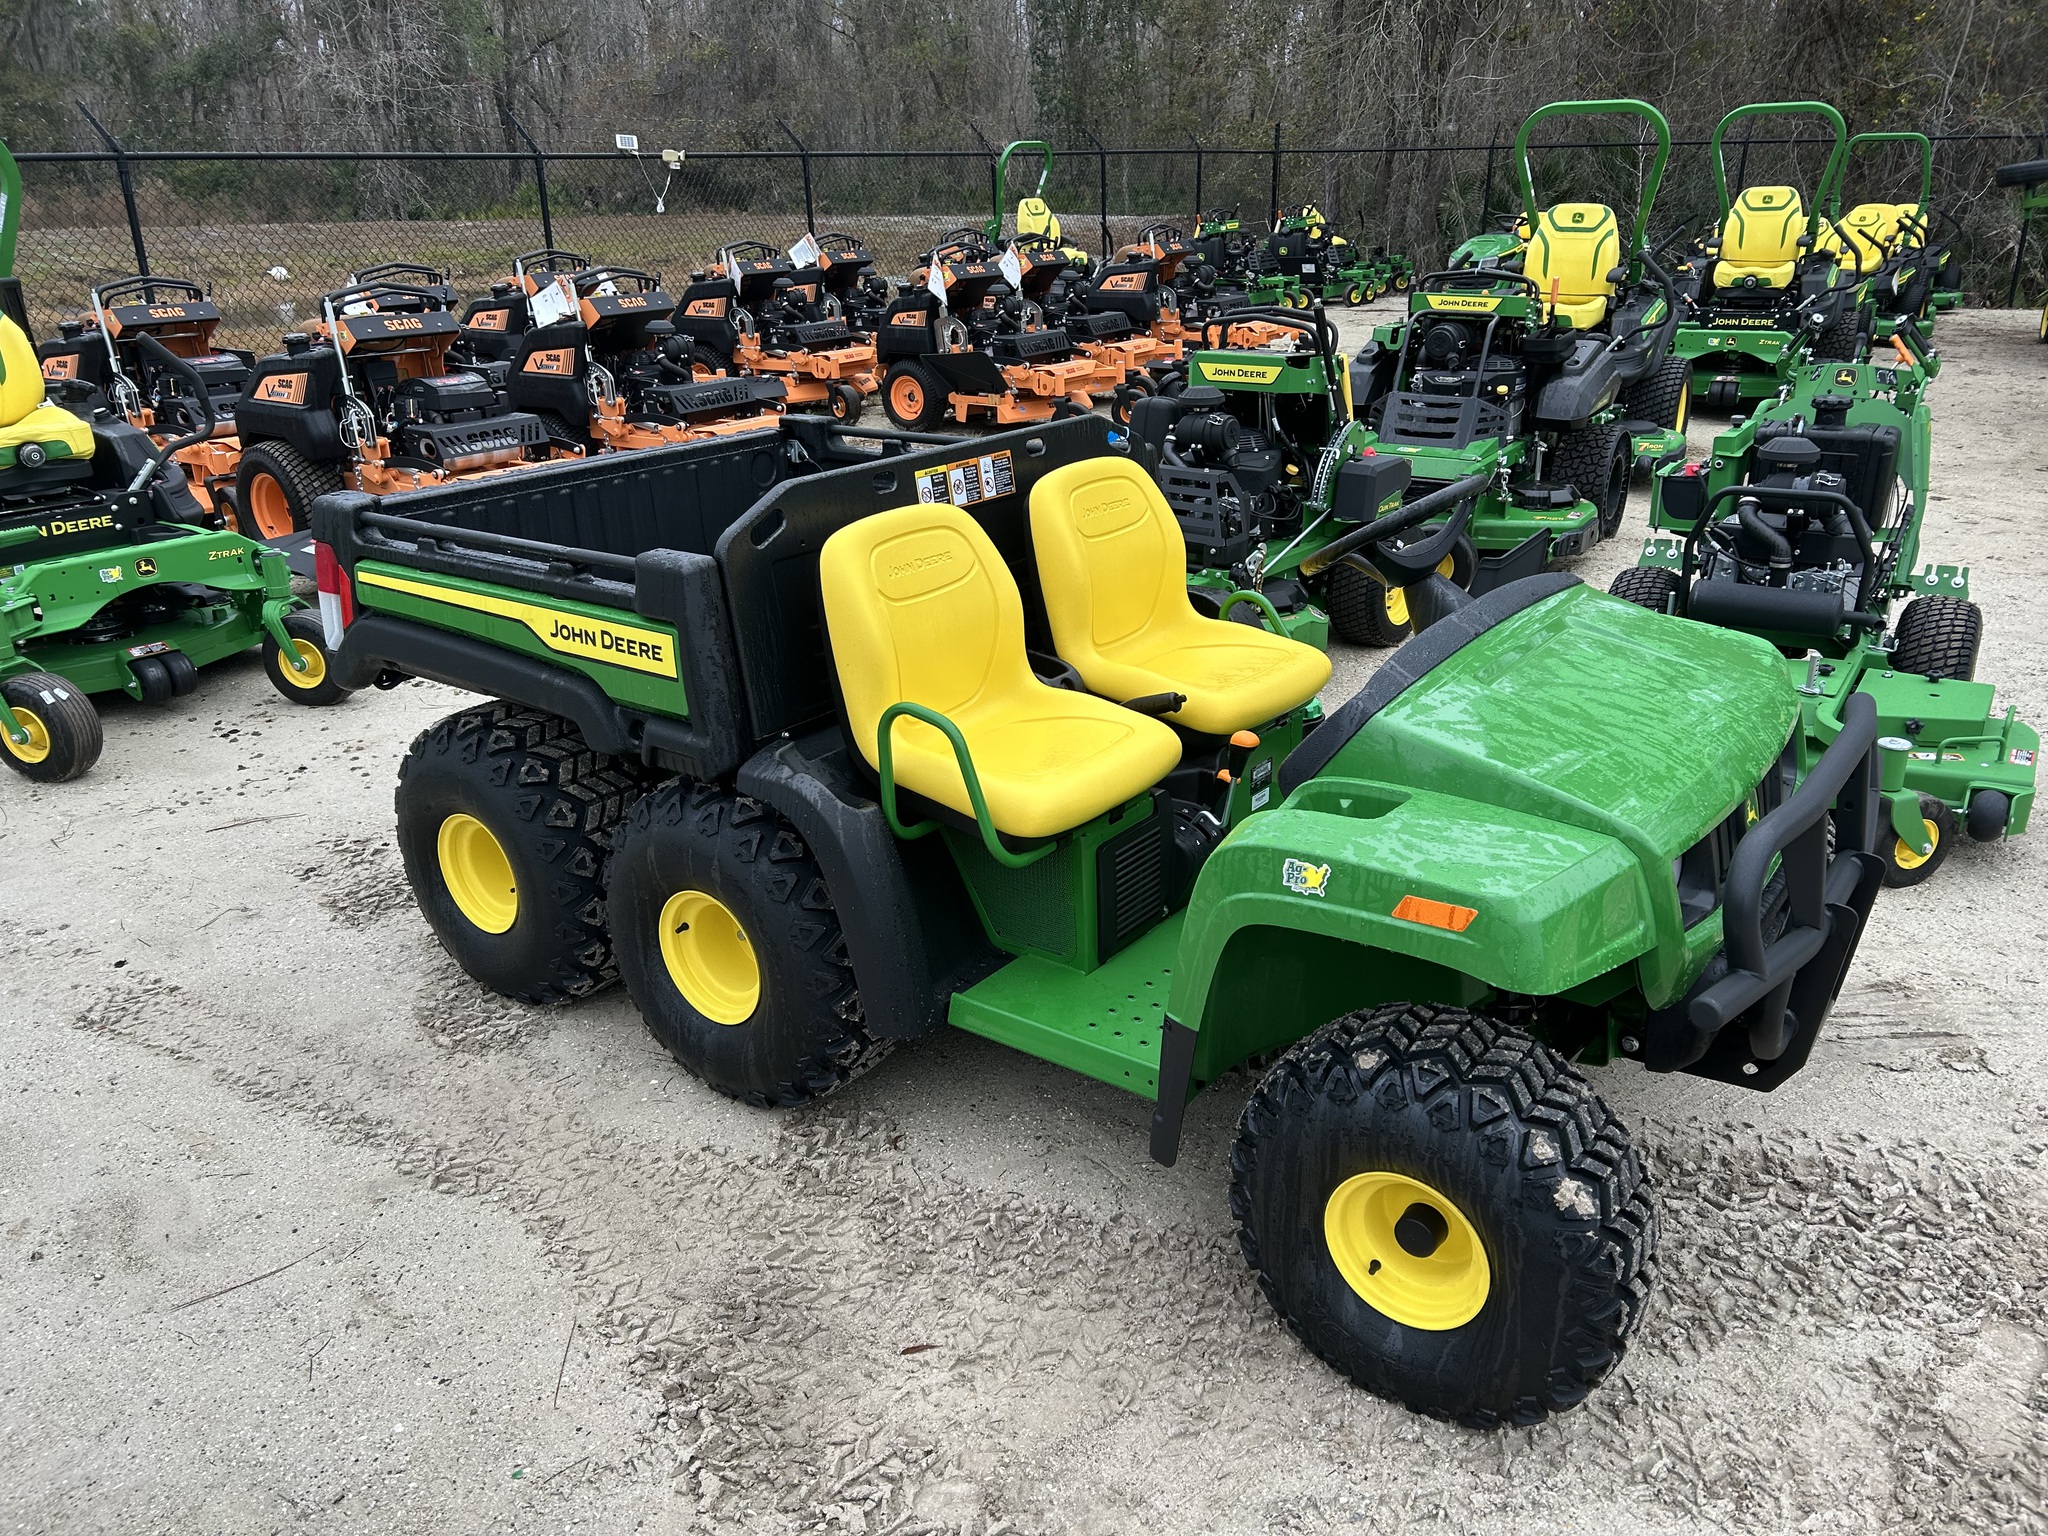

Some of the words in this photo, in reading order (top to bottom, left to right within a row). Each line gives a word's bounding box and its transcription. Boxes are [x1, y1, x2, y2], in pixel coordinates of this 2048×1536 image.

[753, 262, 773, 270] SCAG
[965, 264, 986, 274] SCAG
[618, 296, 648, 308] SCAG
[702, 301, 716, 309] SCAG
[1438, 299, 1460, 307] JOHN
[1461, 299, 1489, 308] DEERE
[148, 306, 186, 319] SCAG
[486, 313, 498, 321] SCAG
[384, 317, 423, 331] SCAG
[1712, 318, 1739, 326] JOHN
[1741, 318, 1774, 326] DEERE
[1033, 338, 1056, 353] SCAG
[56, 360, 68, 369] SCAG
[545, 353, 561, 363] SCAG
[1212, 367, 1236, 377] JOHN
[1237, 368, 1267, 378] DEERE
[277, 378, 293, 389] SCAG
[696, 387, 732, 407] SCAG
[466, 426, 519, 452] SCAG
[1082, 505, 1101, 520] JOHN
[1101, 497, 1131, 515] DEERE
[50, 515, 113, 535] DEERE
[208, 547, 245, 561] ZTRAK
[888, 560, 915, 580] JOHN
[916, 550, 952, 573] DEERE
[550, 619, 597, 647] JOHN
[600, 629, 663, 663] DEERE
[1287, 861, 1308, 875] Ag-
[1286, 872, 1307, 885] Pro
